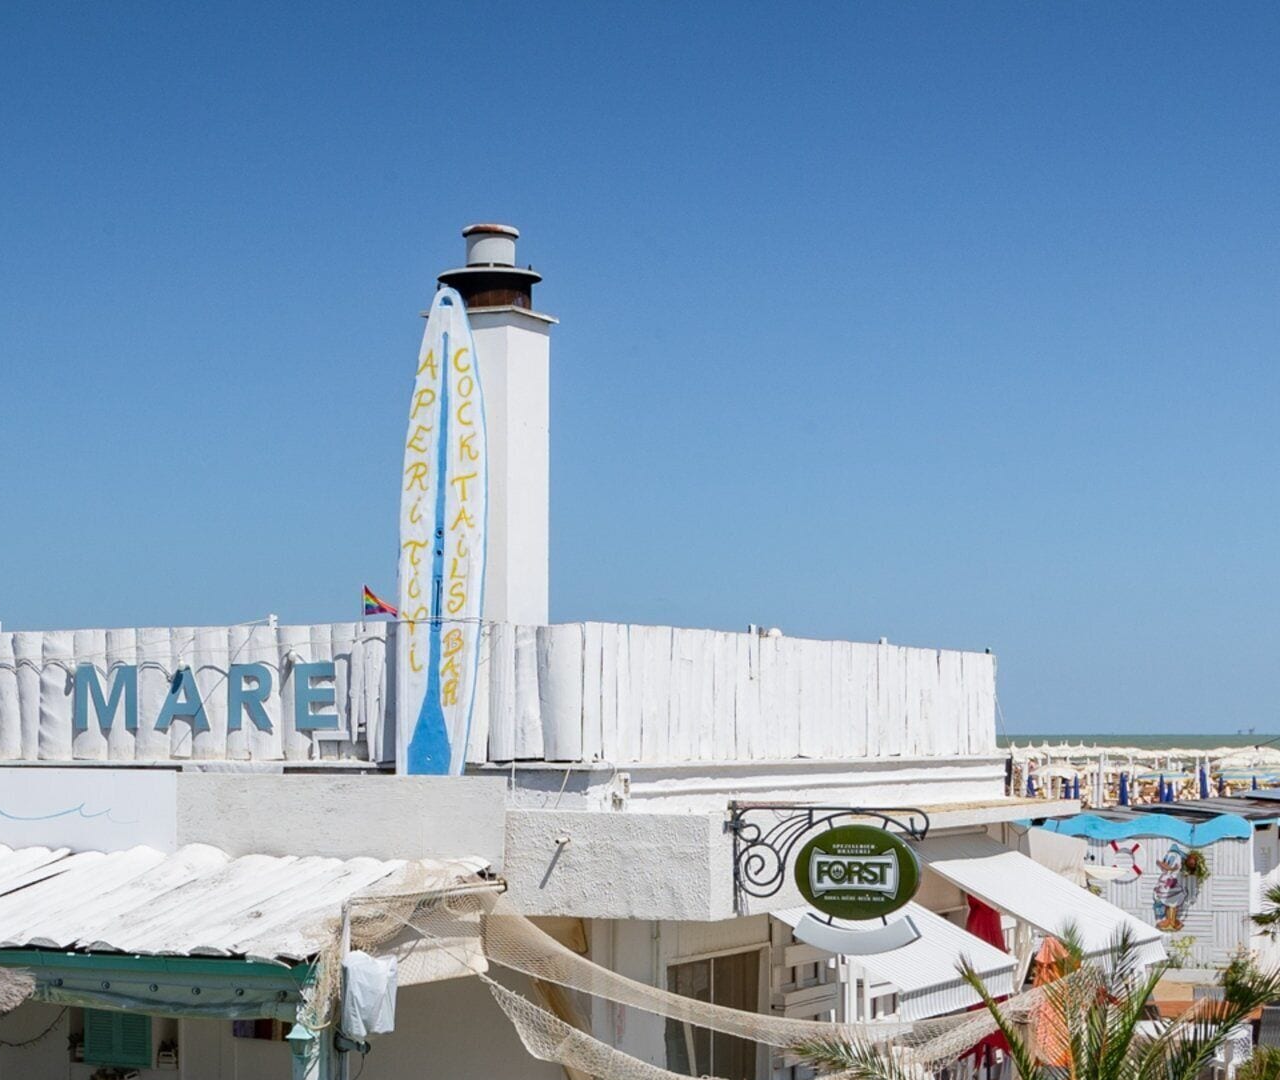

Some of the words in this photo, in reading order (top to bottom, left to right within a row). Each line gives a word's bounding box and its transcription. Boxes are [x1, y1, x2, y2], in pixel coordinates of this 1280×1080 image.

[74, 661, 339, 730] MARE
[440, 628, 465, 707] BAR
[816, 861, 893, 885] FORST
